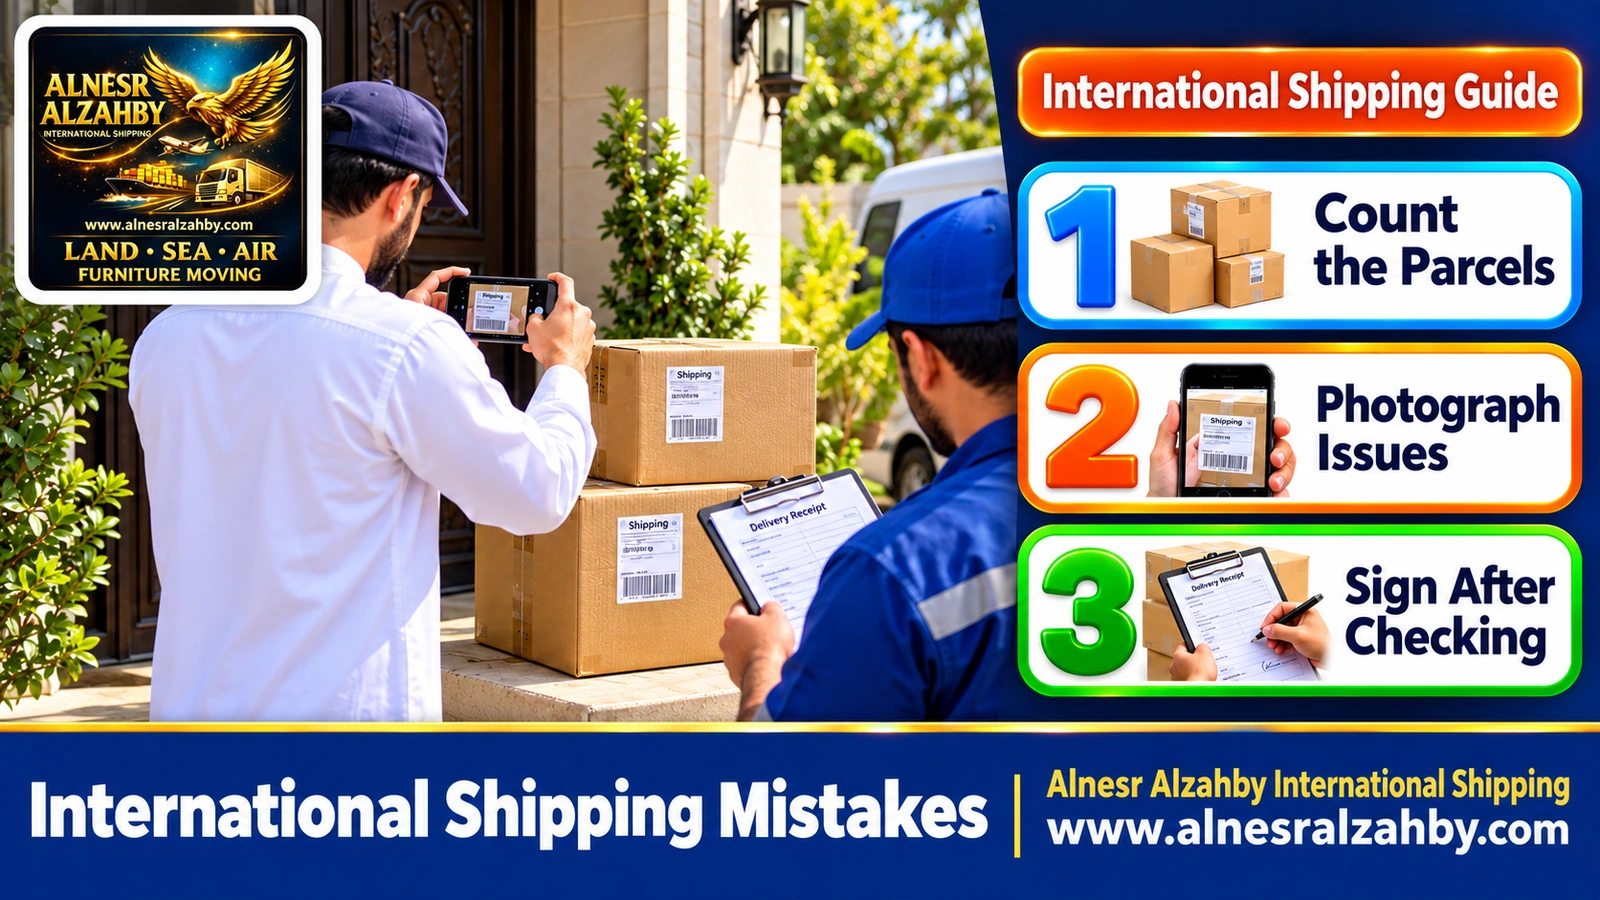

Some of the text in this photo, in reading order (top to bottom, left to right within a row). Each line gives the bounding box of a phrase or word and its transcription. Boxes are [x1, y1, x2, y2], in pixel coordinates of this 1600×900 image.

[677, 370, 712, 380] Shipping
[1210, 417, 1243, 426] Shipping
[749, 515, 789, 532] Delivery
[790, 502, 827, 519] Receipt
[629, 519, 669, 531] Shipping
